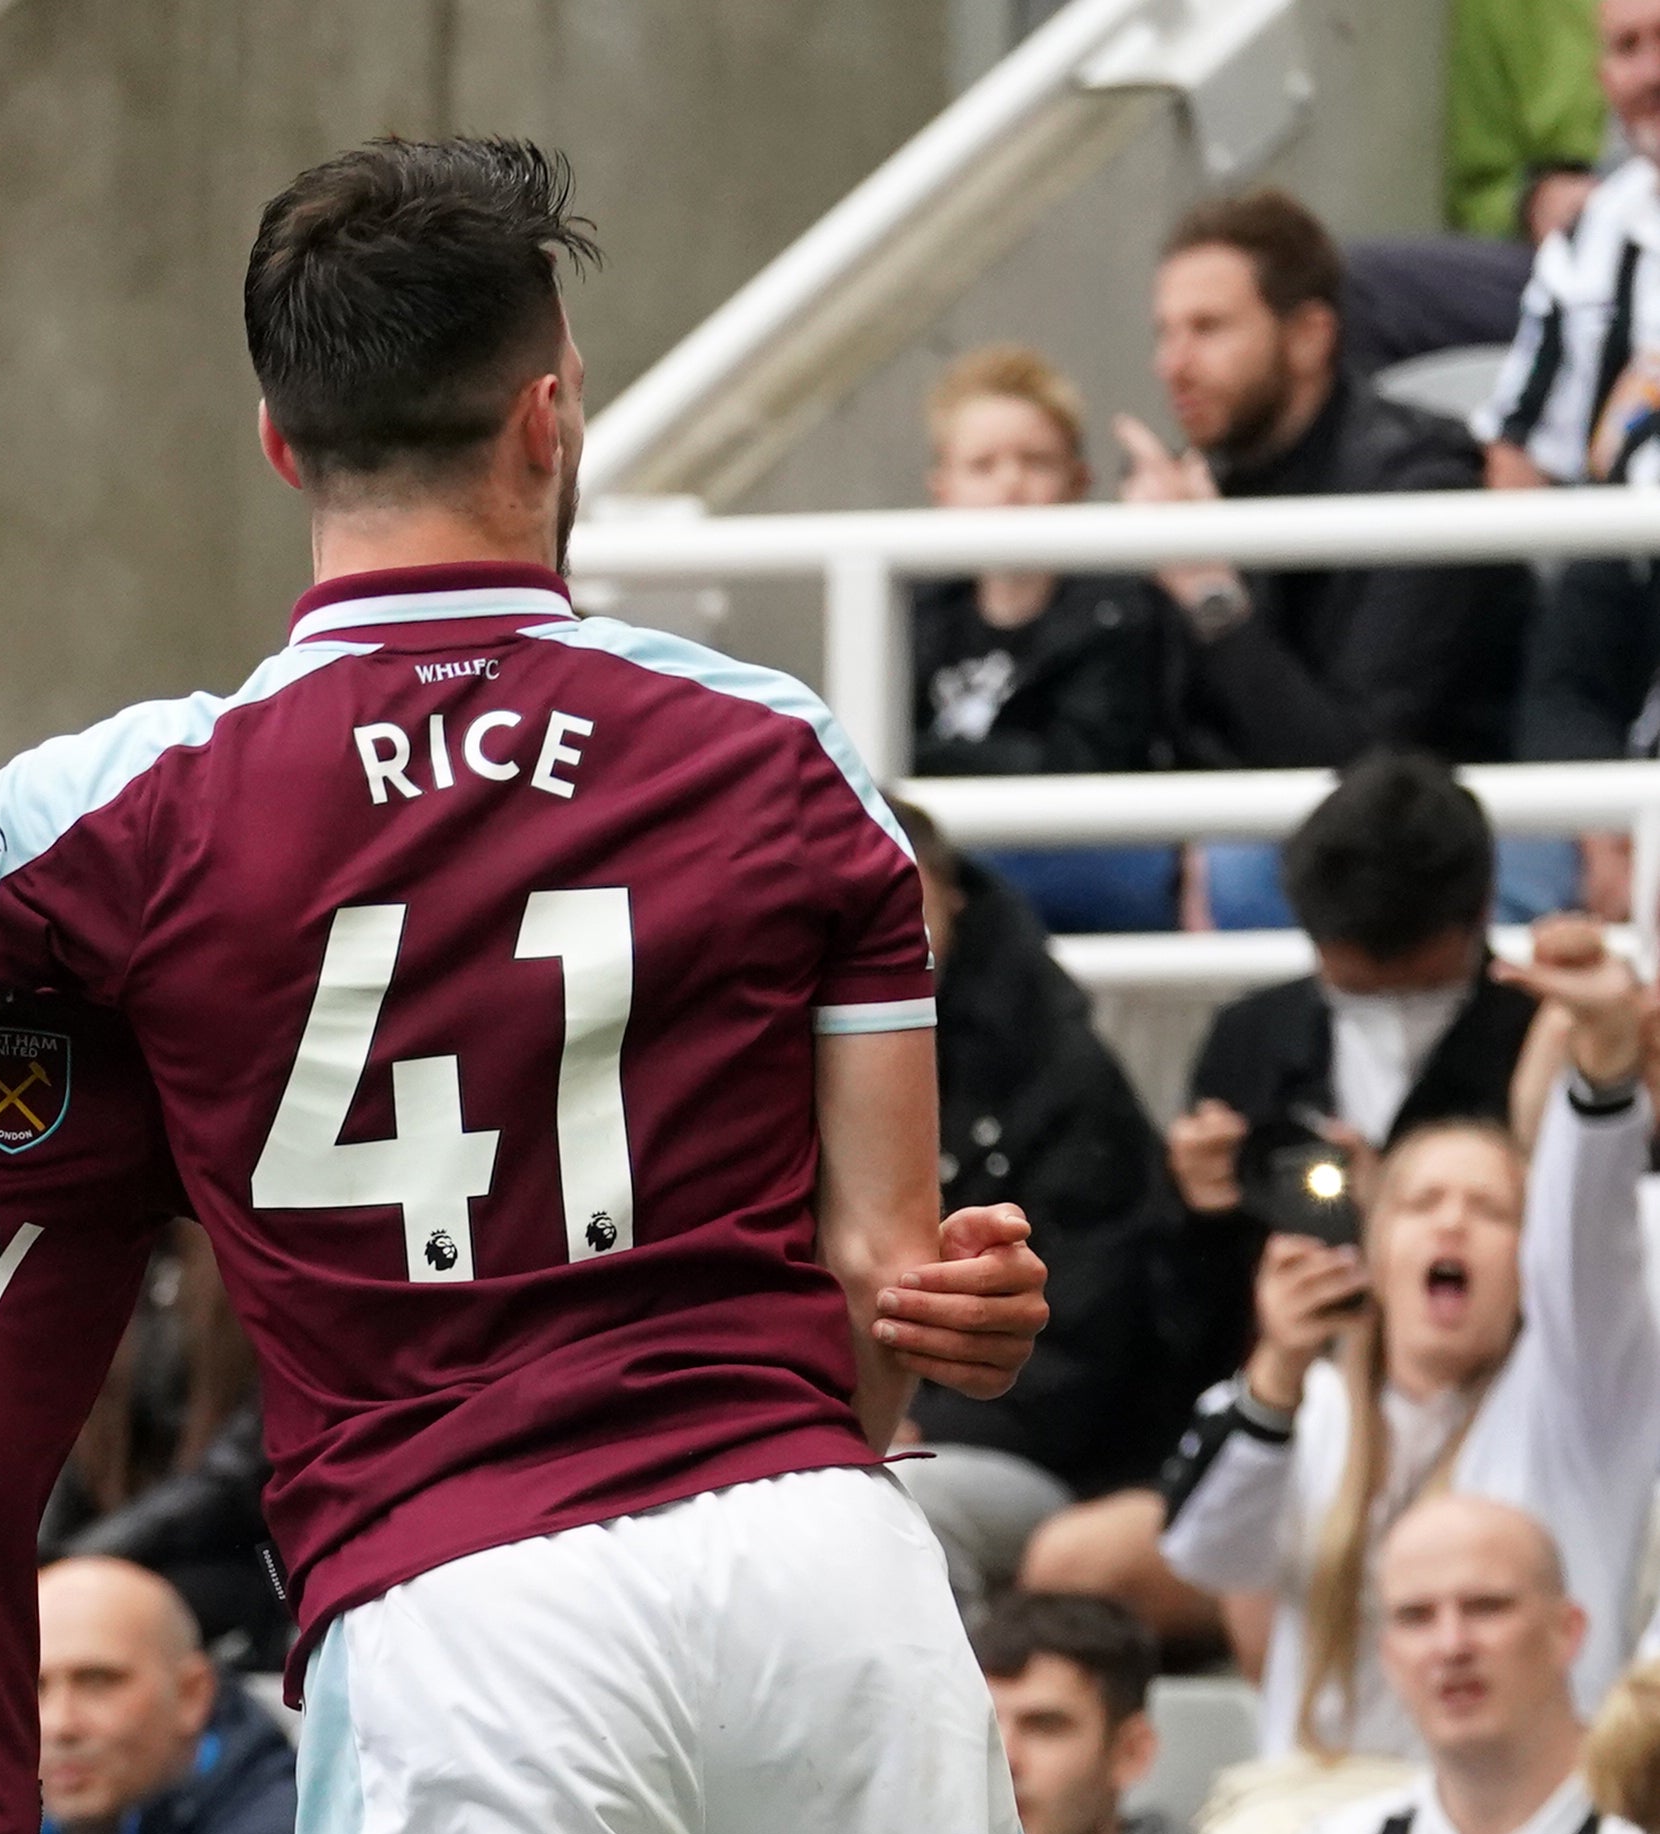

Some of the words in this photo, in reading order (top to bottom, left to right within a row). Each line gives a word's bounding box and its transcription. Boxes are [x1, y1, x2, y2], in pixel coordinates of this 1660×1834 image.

[353, 710, 594, 804] RICE
[15, 1034, 58, 1051] HAM
[250, 886, 634, 1283] 41
